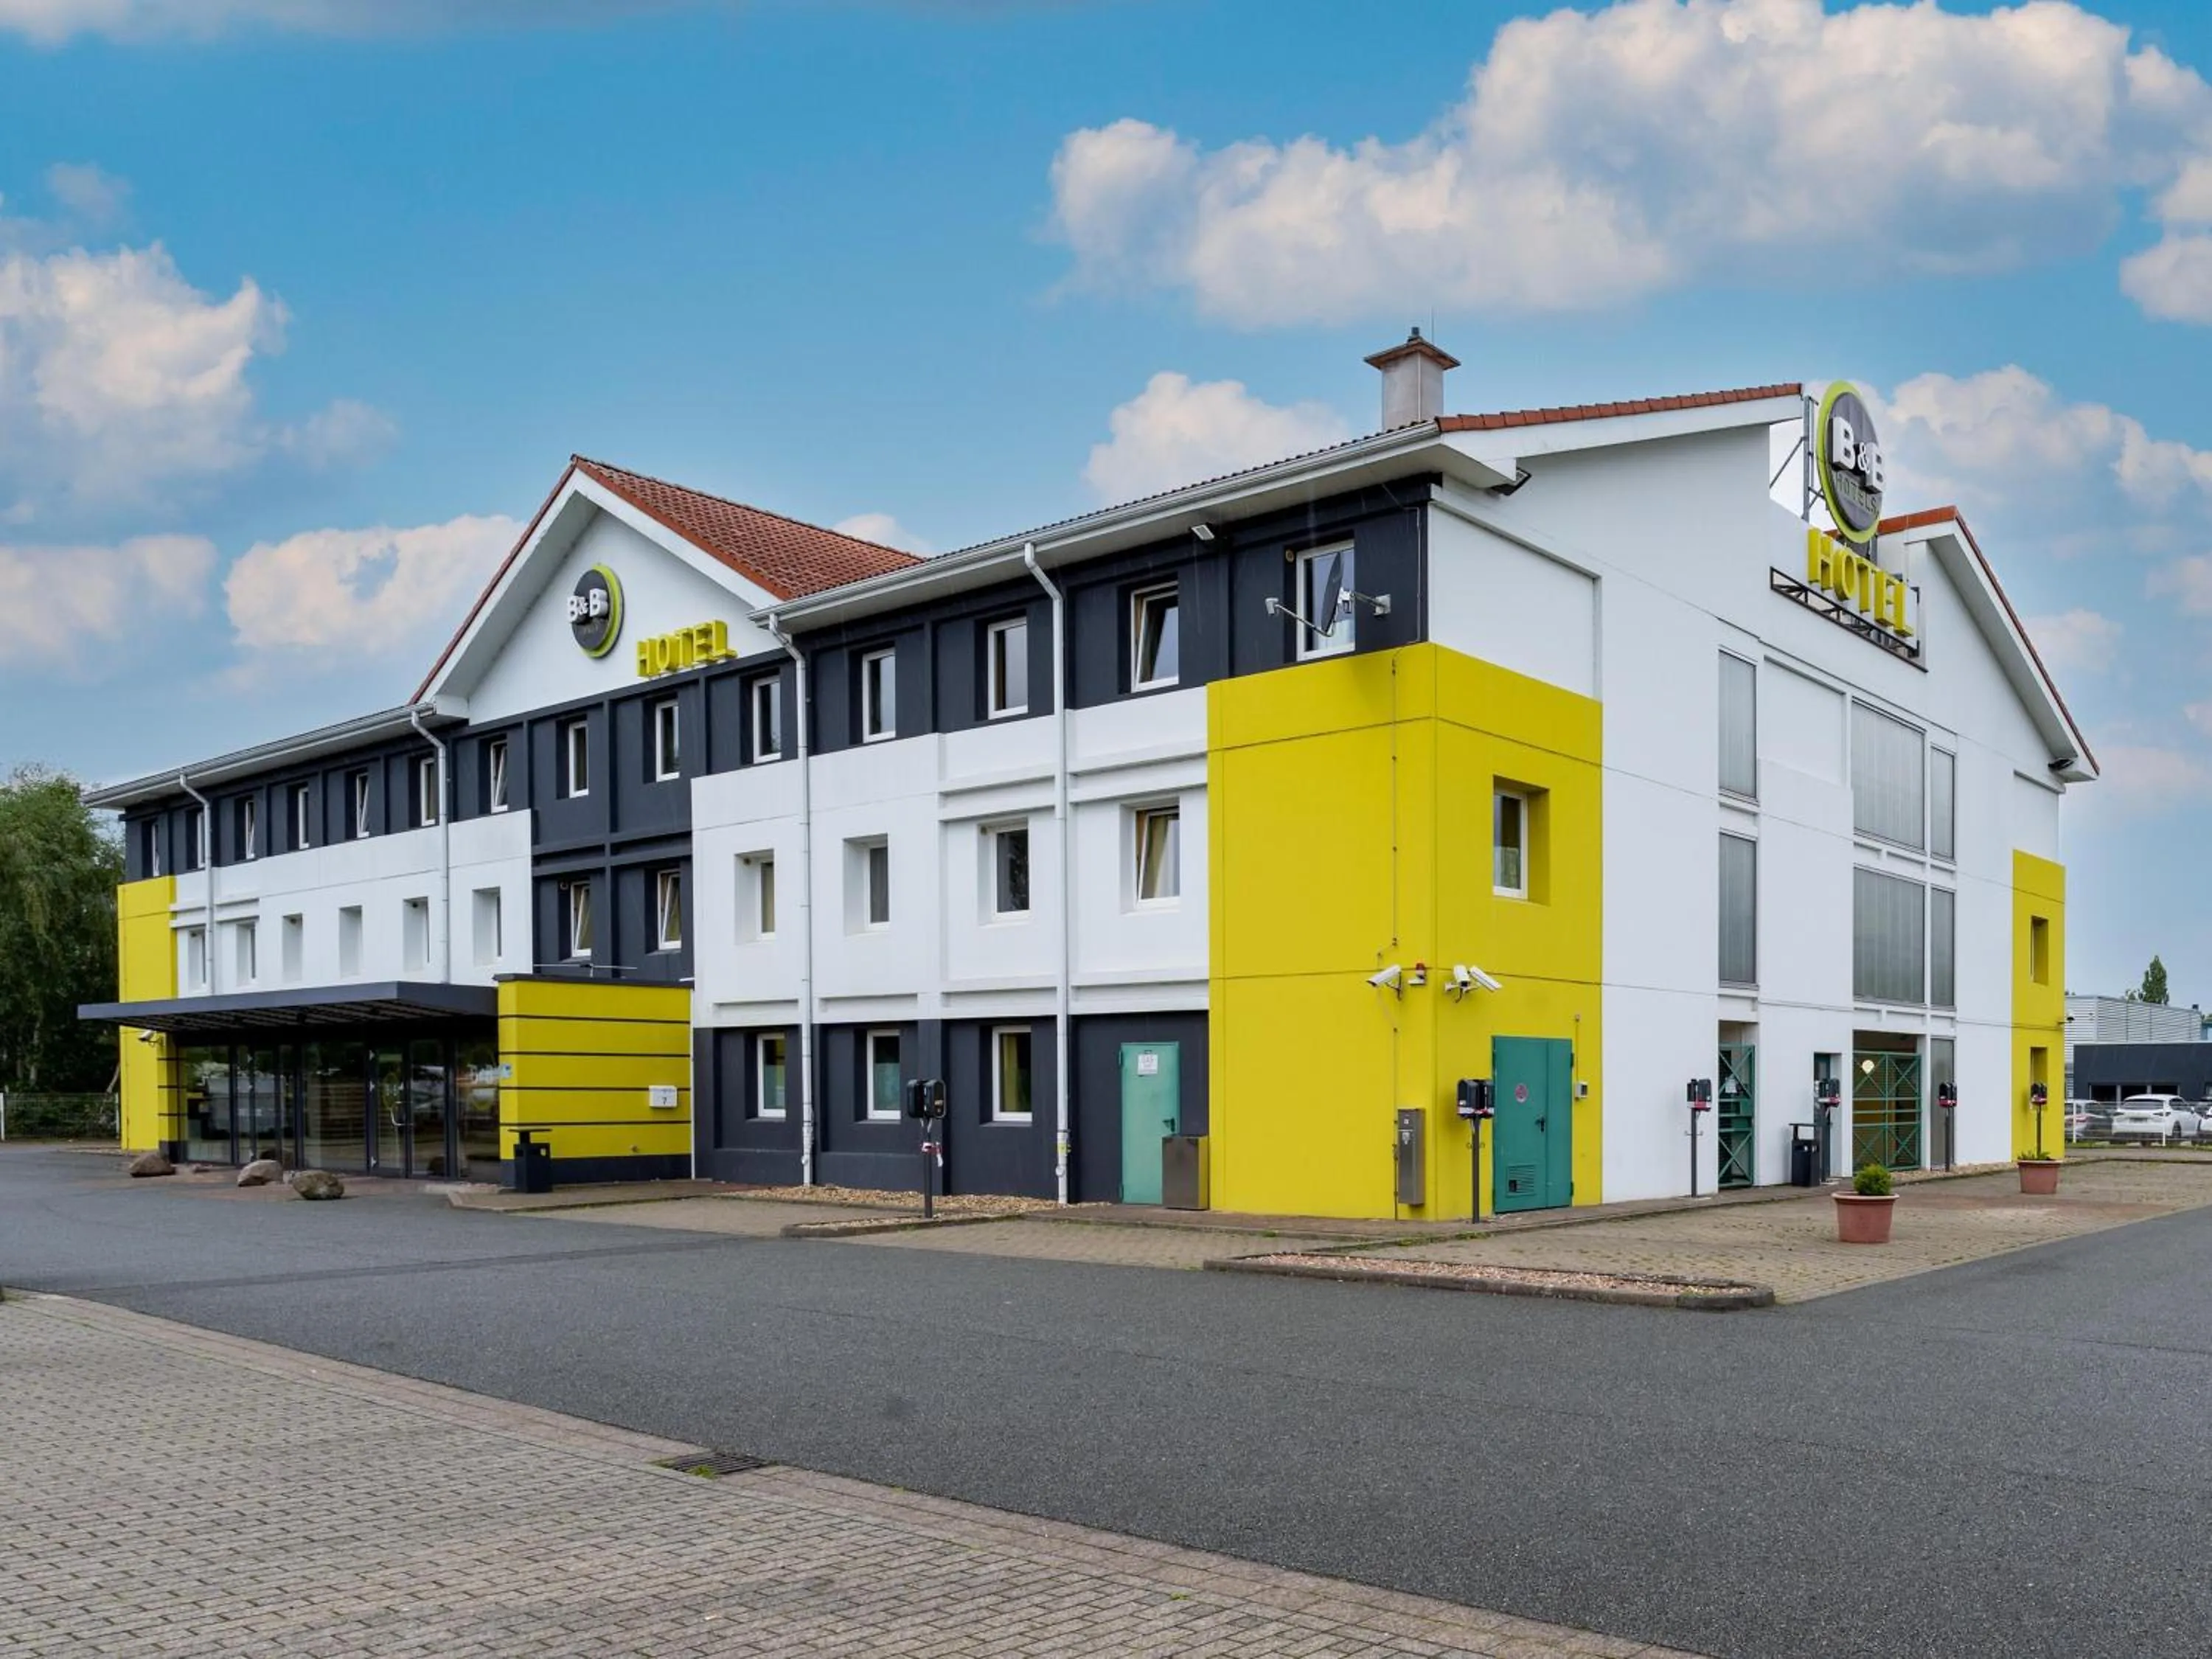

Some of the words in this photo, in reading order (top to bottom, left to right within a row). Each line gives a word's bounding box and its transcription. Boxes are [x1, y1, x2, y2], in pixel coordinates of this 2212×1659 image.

[1832, 417, 1886, 493] B&B
[568, 588, 607, 622] B&B
[1806, 527, 1913, 637] HOTEL
[637, 620, 737, 678] HOTEL
